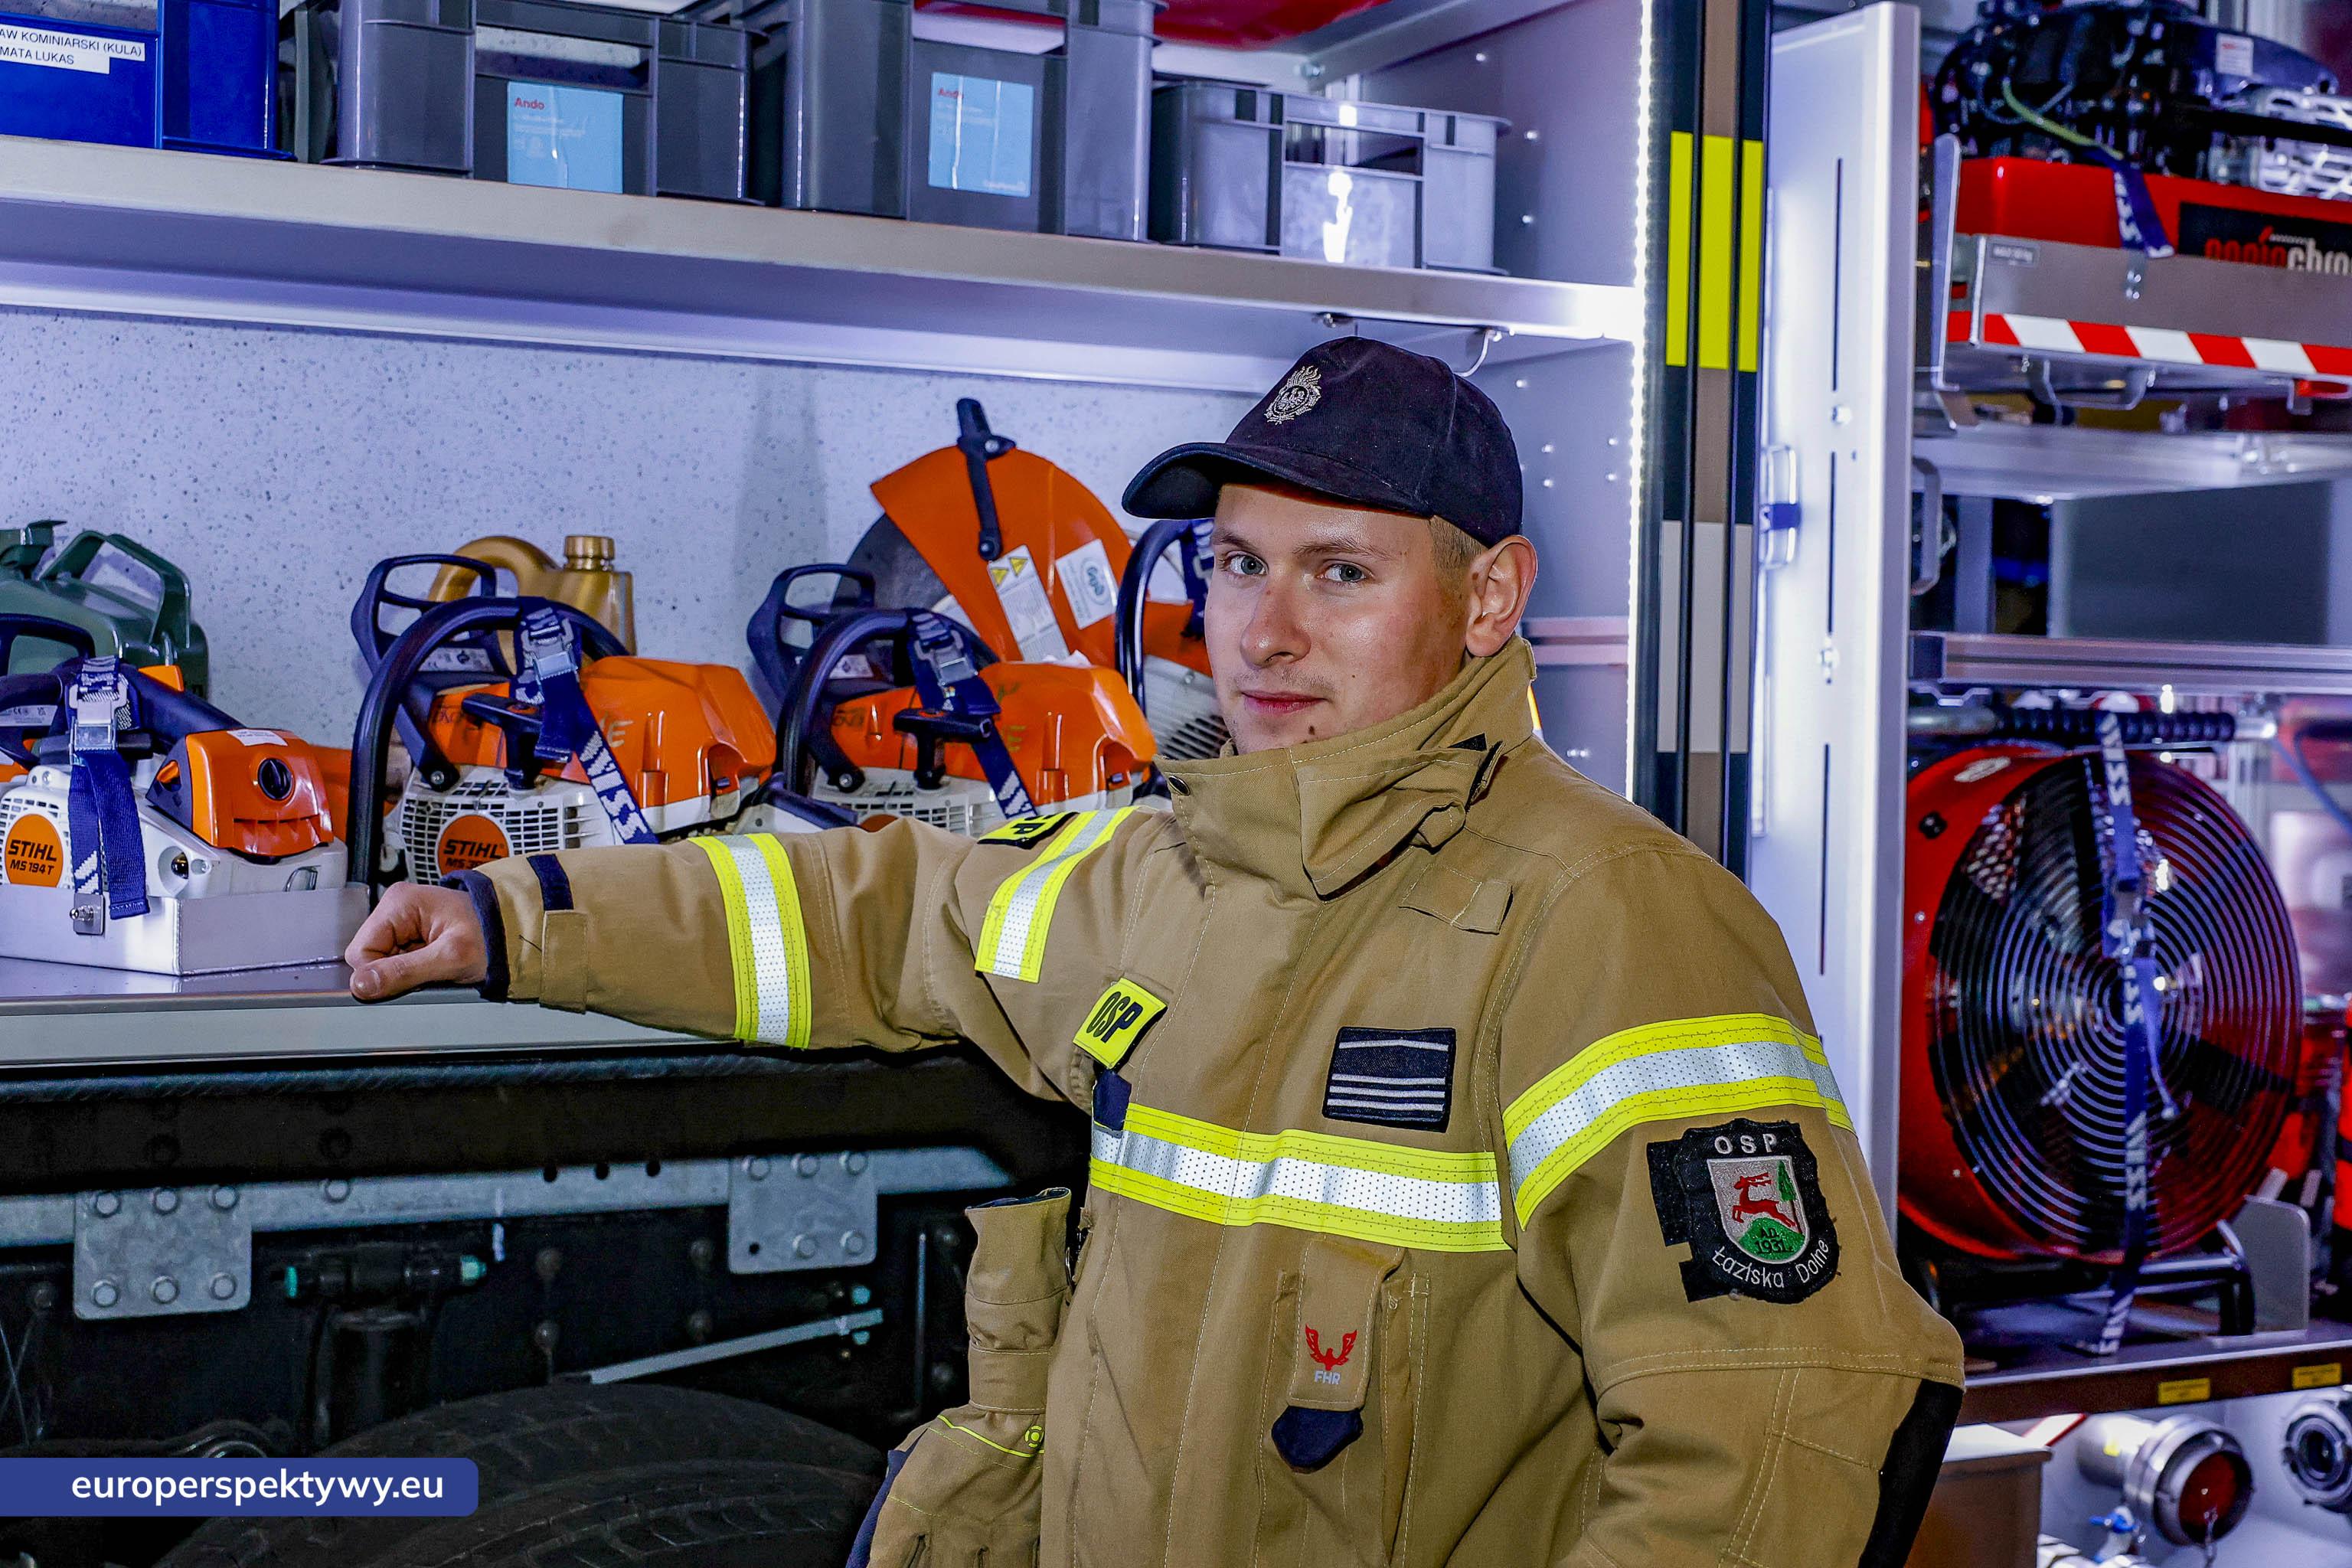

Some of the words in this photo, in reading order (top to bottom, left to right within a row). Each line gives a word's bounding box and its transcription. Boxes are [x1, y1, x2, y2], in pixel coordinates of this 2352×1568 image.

[21, 31, 100, 51] KOMINIARSKI
[103, 42, 142, 57] (KULA)
[35, 51, 74, 64] LUKAS
[514, 97, 545, 110] Ando
[8, 839, 57, 862] STIHL
[443, 839, 502, 859] STIHL
[10, 859, 28, 871] MS
[28, 862, 46, 874] 194
[47, 865, 55, 875] T
[1086, 991, 1144, 1044] OSP
[1713, 1132, 1778, 1155] OSP
[1711, 1245, 1785, 1289] Łaziska
[1795, 1238, 1830, 1284] Dolne
[1314, 1370, 1341, 1385] FHR
